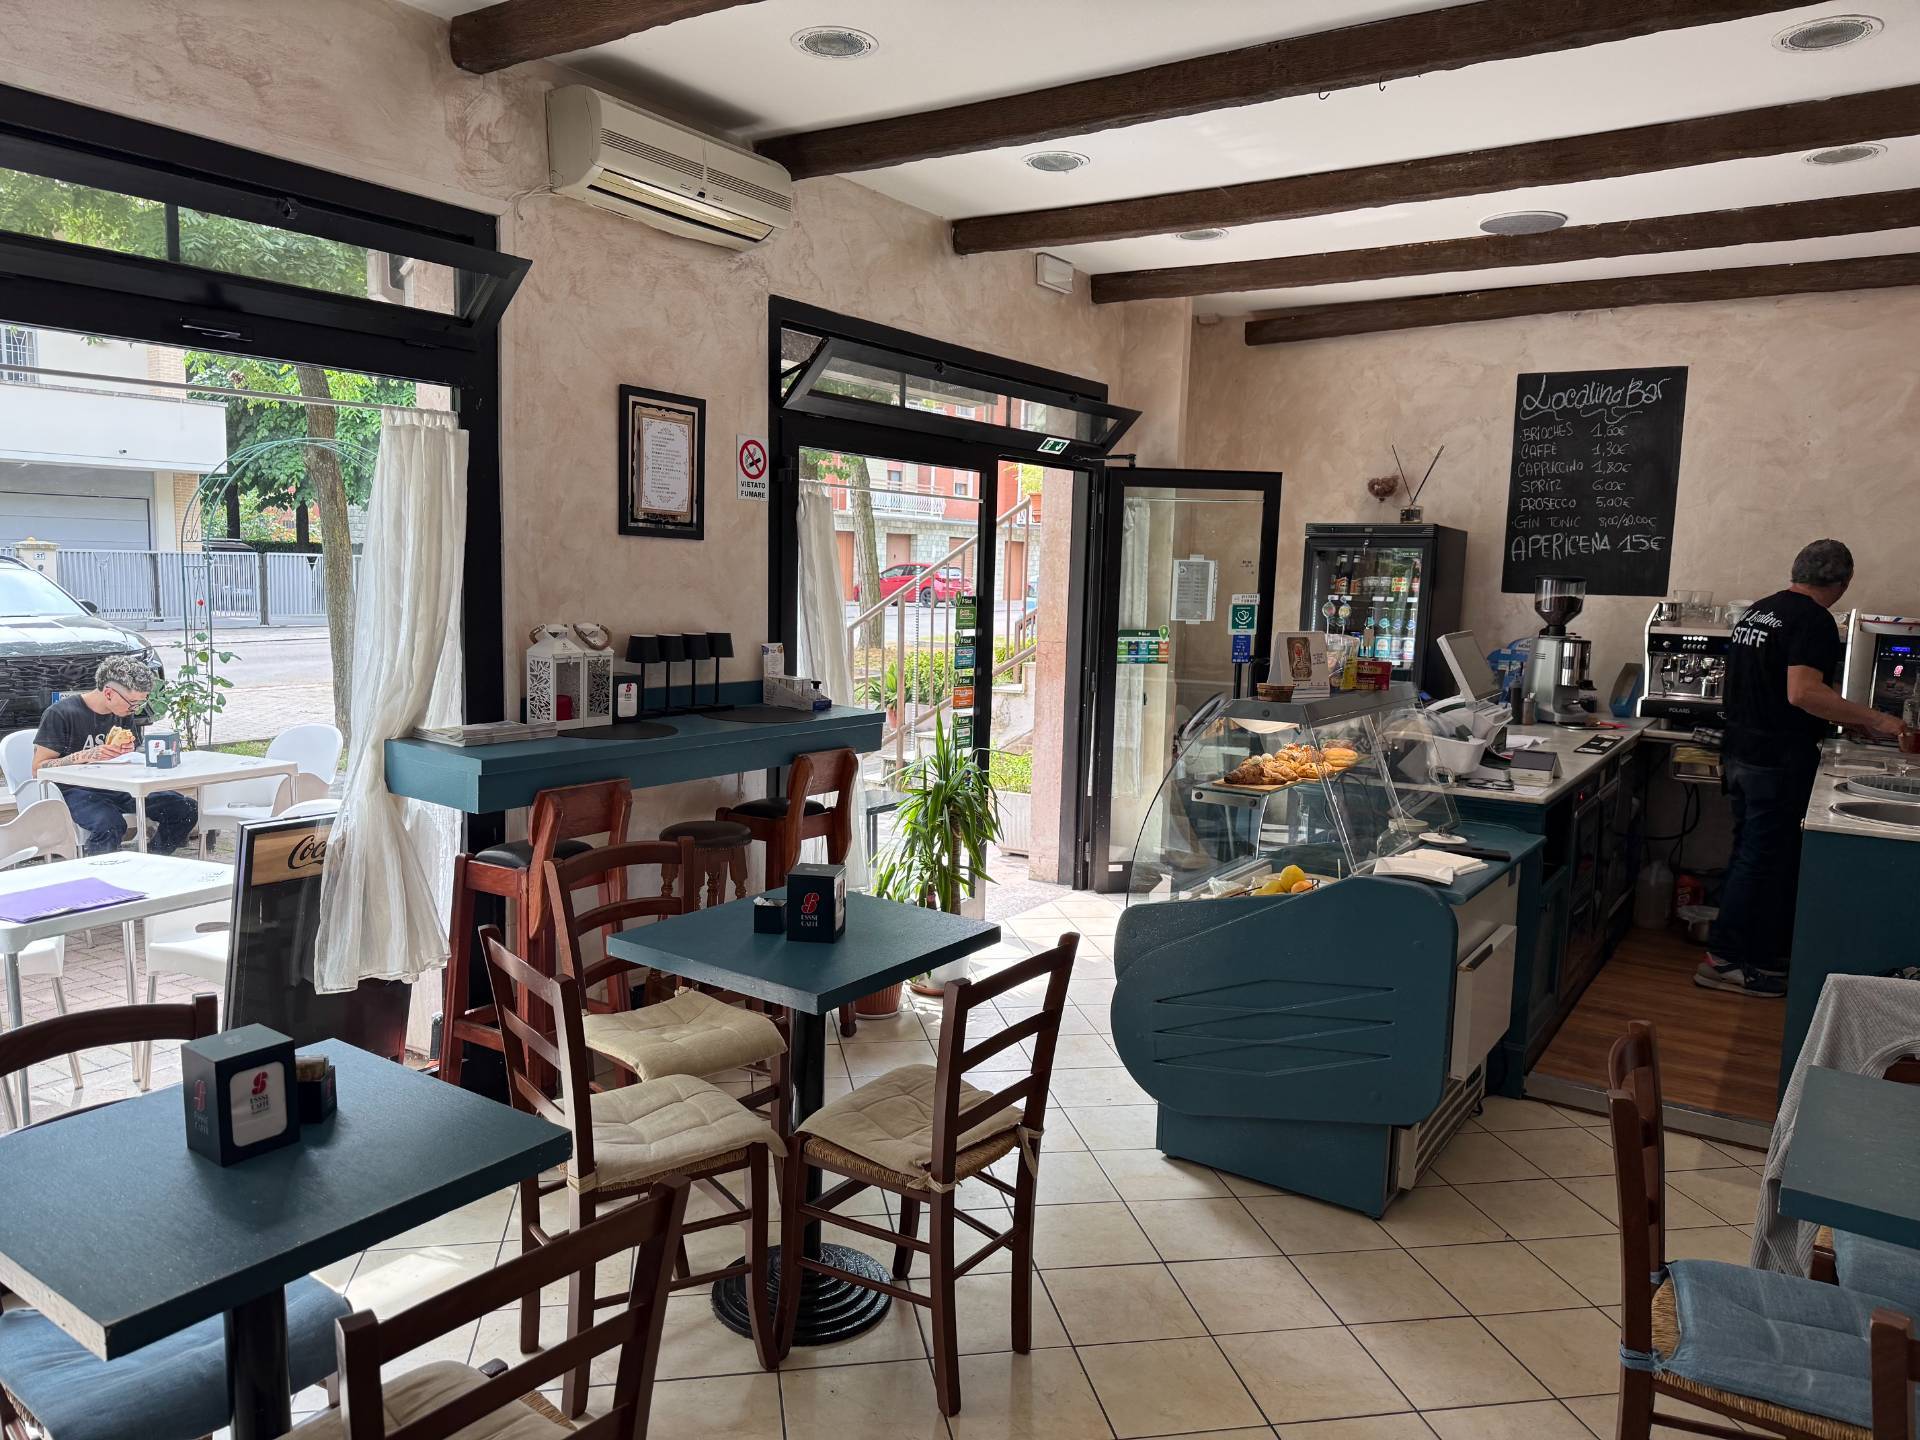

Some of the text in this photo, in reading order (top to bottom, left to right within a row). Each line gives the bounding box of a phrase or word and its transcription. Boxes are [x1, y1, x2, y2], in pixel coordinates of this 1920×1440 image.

[1522, 375, 1671, 411] Localino Bar
[740, 480, 766, 489] VIETATO
[740, 490, 766, 499] FUMARE
[1520, 497, 1577, 512] PROSECCO
[1617, 534, 1666, 553] 15€
[1732, 626, 1769, 648] STAFF
